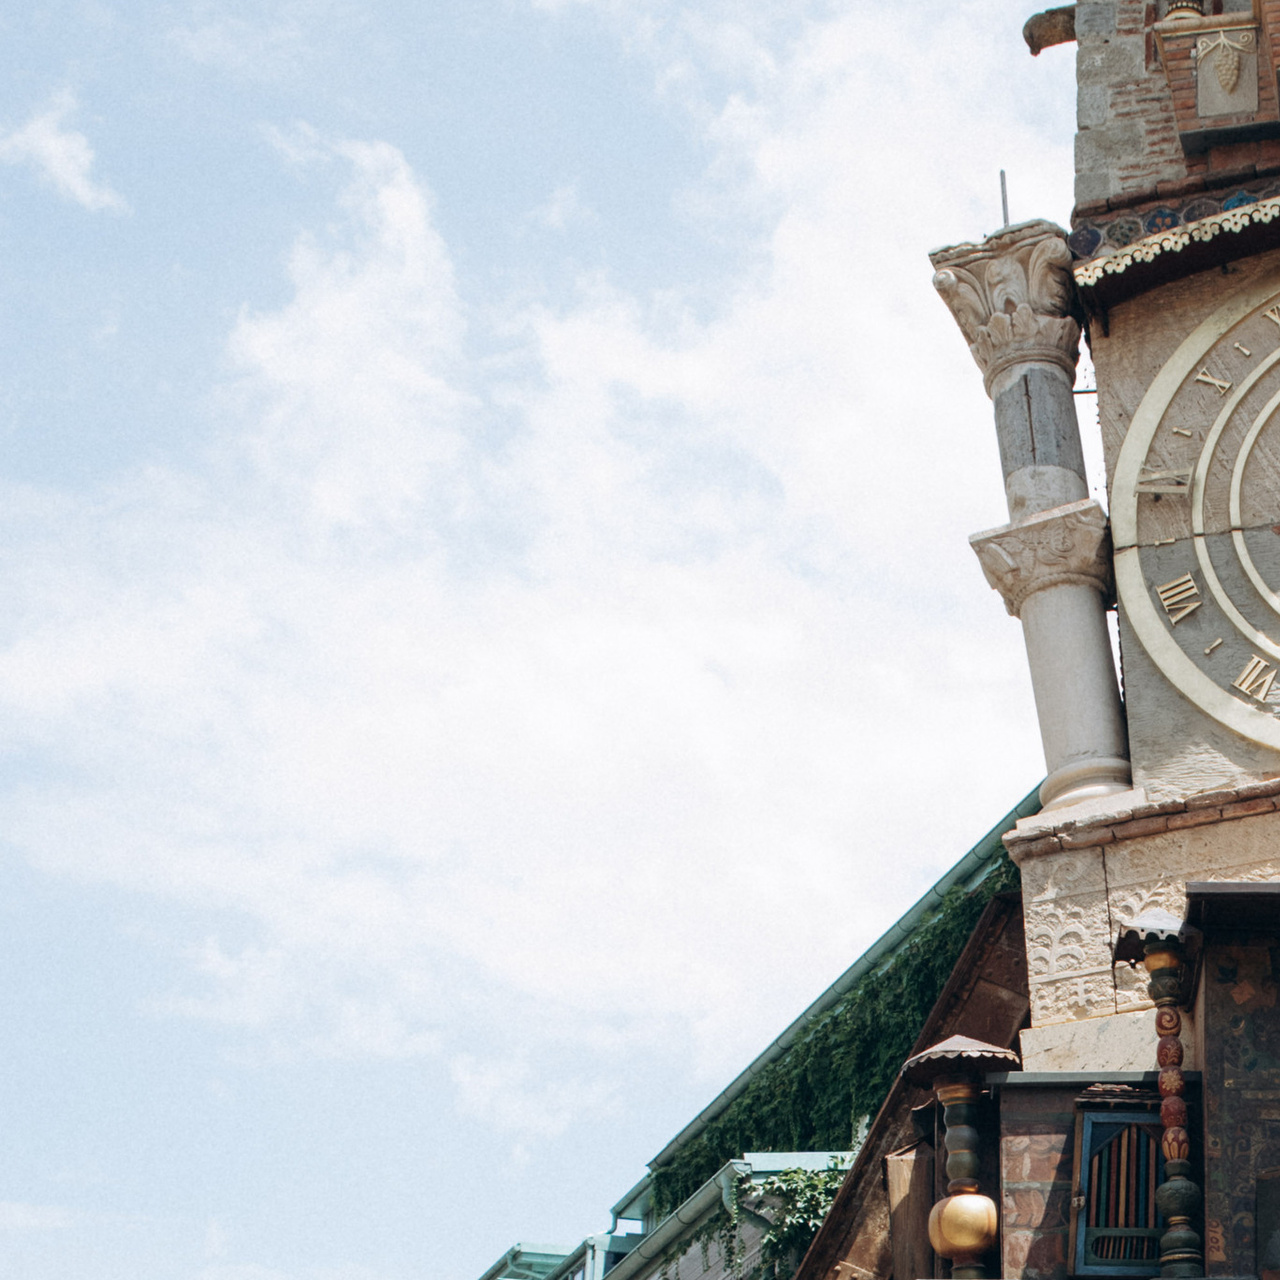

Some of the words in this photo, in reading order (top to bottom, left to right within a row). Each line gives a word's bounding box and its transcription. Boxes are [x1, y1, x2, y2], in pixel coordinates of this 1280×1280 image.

[1194, 367, 1233, 396] X
[1156, 571, 1202, 626] VIII
[1231, 654, 1278, 702] VII
